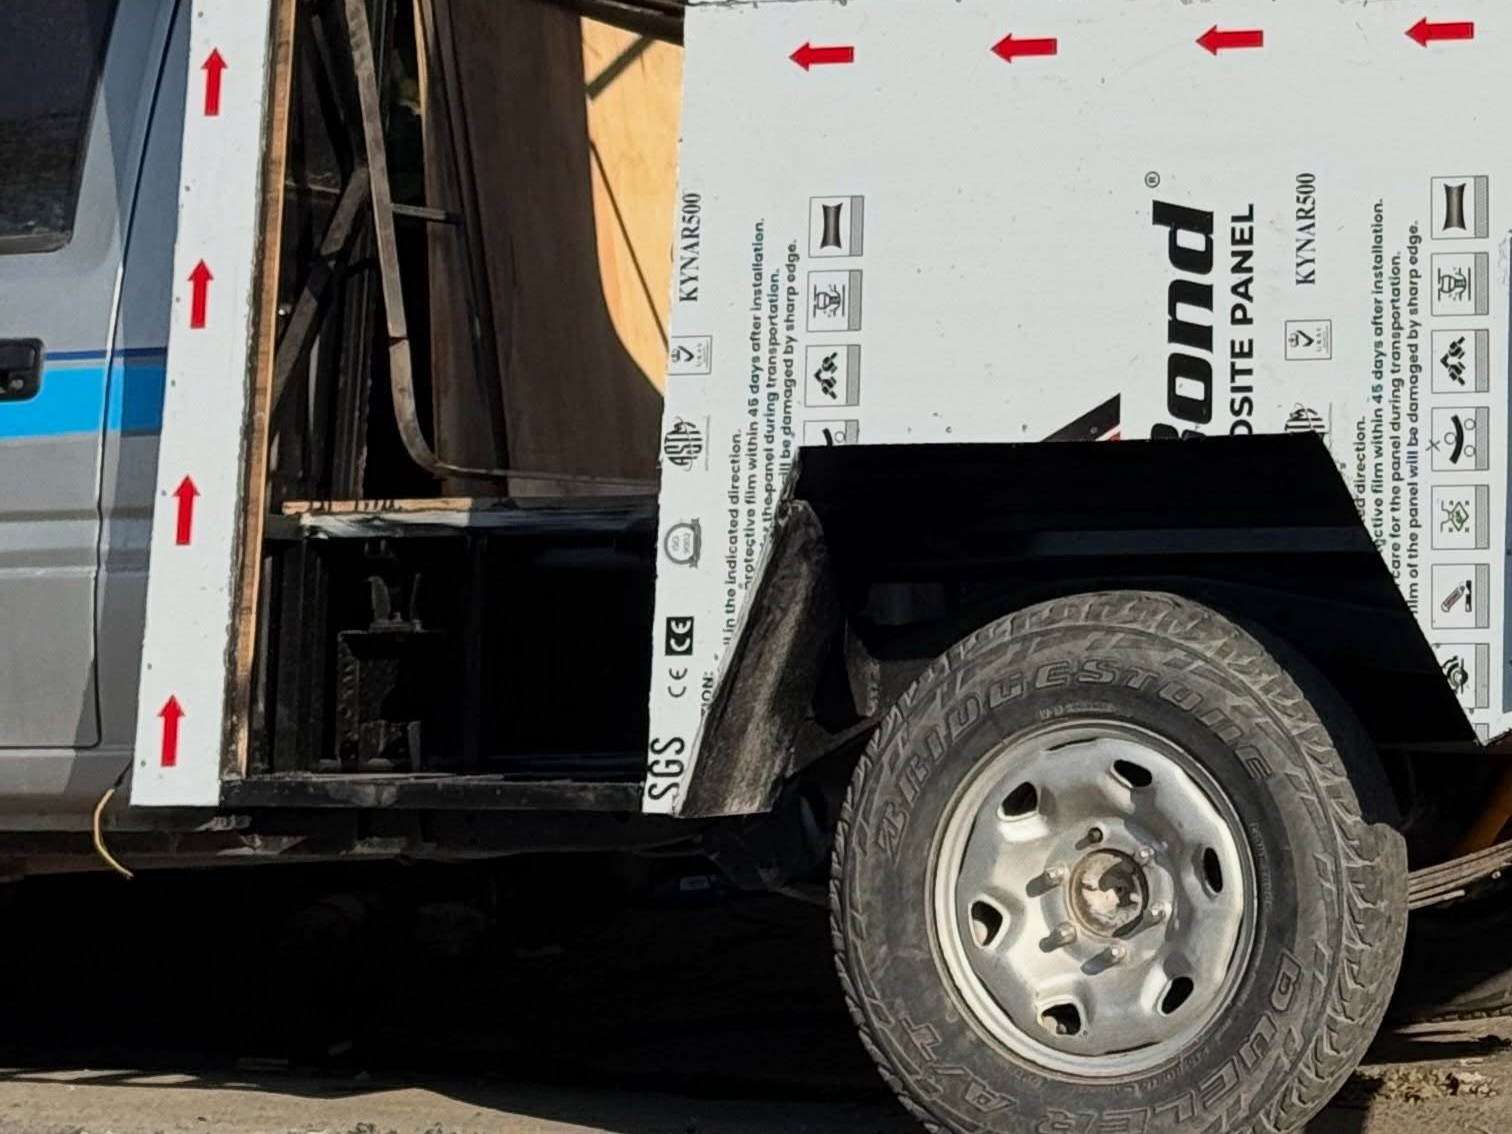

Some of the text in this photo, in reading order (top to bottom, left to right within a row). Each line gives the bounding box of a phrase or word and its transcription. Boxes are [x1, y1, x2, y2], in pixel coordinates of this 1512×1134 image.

[680, 193, 702, 302] KYNAR500
[1295, 173, 1318, 287] KYNAR500
[1371, 197, 1385, 295] installation.
[1407, 220, 1424, 266] edge.
[750, 219, 766, 312] installation.
[784, 239, 800, 284] edge.
[1229, 204, 1255, 326] PANEL
[781, 287, 799, 332] sharp
[1389, 251, 1406, 374] transportation.
[1407, 269, 1423, 316] sharp
[750, 315, 763, 353] after
[763, 269, 782, 389] transportation.
[1371, 297, 1386, 337] after
[1406, 319, 1423, 341] by
[780, 335, 796, 357] by
[1371, 340, 1388, 381] days
[748, 357, 764, 395] days
[777, 358, 796, 436] damaged
[1371, 385, 1385, 405] 45
[1406, 343, 1423, 425] damaged
[748, 398, 760, 418] 45
[763, 393, 780, 445] during
[1388, 377, 1405, 433] during
[745, 423, 759, 472] within
[776, 440, 791, 460] be
[1352, 416, 1370, 494] direction.
[1369, 409, 1385, 457] within
[1405, 426, 1419, 448] be
[728, 429, 745, 506] direction.
[761, 448, 779, 496] panel
[1369, 457, 1385, 494] film
[1388, 436, 1405, 482] panel
[1404, 450, 1419, 479] will
[742, 475, 758, 505] film
[1388, 485, 1402, 513] the
[1405, 482, 1422, 530] panel
[724, 513, 741, 584] indicated
[1388, 515, 1402, 539] for
[1405, 531, 1419, 560] the
[1405, 562, 1419, 582] of
[724, 587, 738, 615] the
[722, 619, 736, 634] in
[667, 667, 687, 699] CE
[648, 737, 685, 802] SGS
